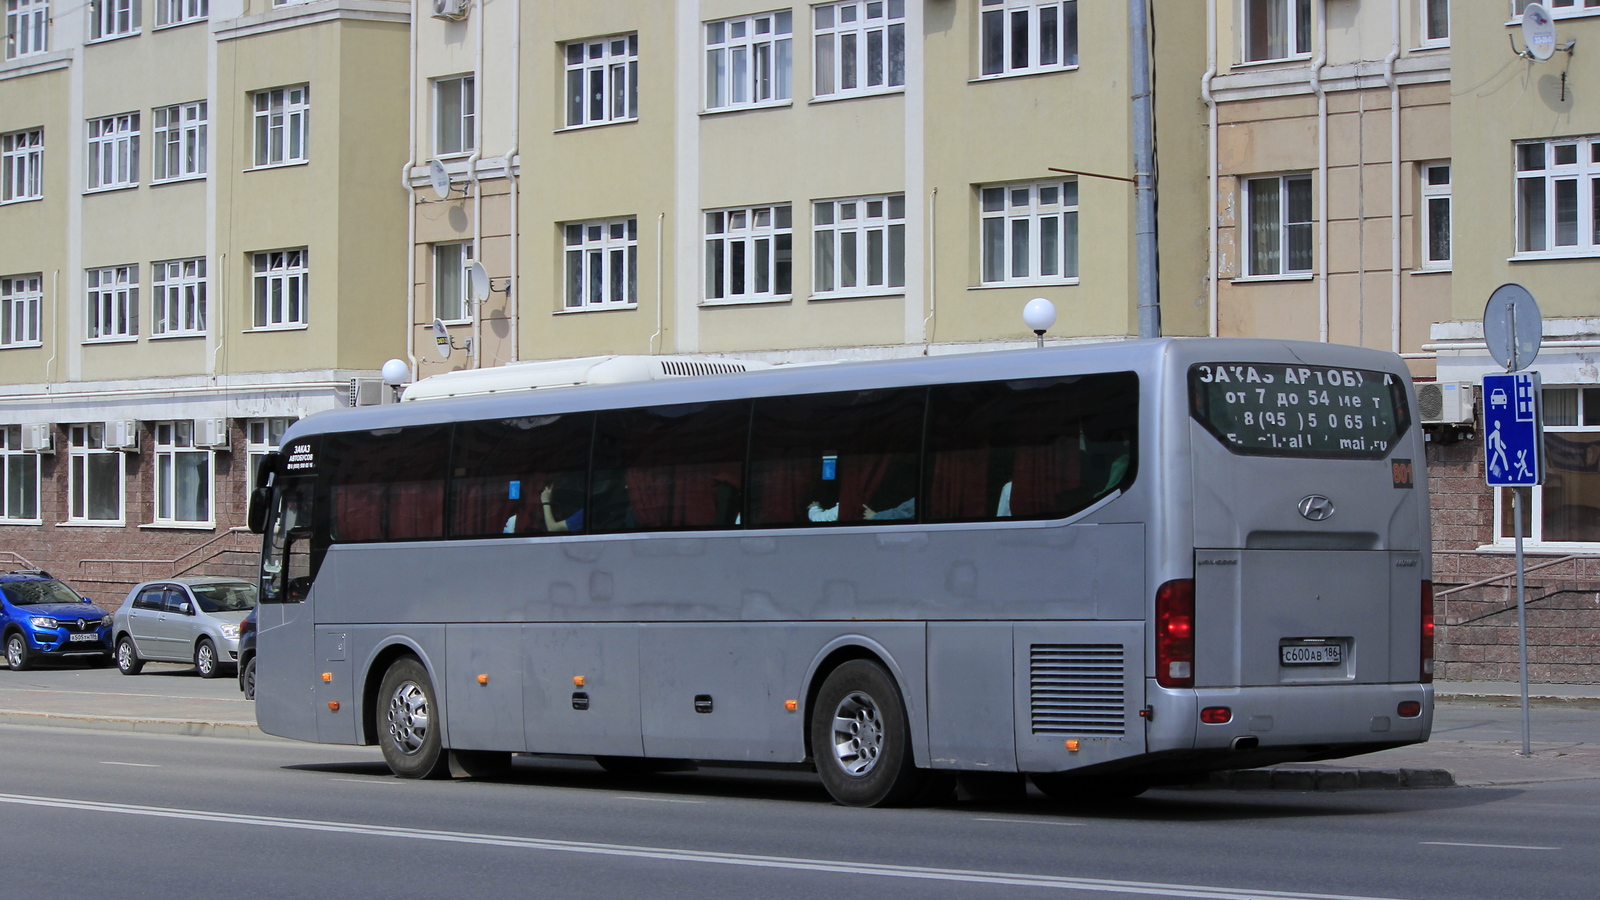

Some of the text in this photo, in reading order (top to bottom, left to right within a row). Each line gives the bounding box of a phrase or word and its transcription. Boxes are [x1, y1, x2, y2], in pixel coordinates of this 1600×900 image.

[1225, 391, 1246, 404] от
[1255, 388, 1266, 404] 7
[1277, 393, 1299, 407] до
[1308, 390, 1330, 406] 54
[294, 445, 311, 454] ЗАКАЗ
[1392, 463, 1413, 483] 801
[1285, 647, 1338, 661] С600АВ 186
